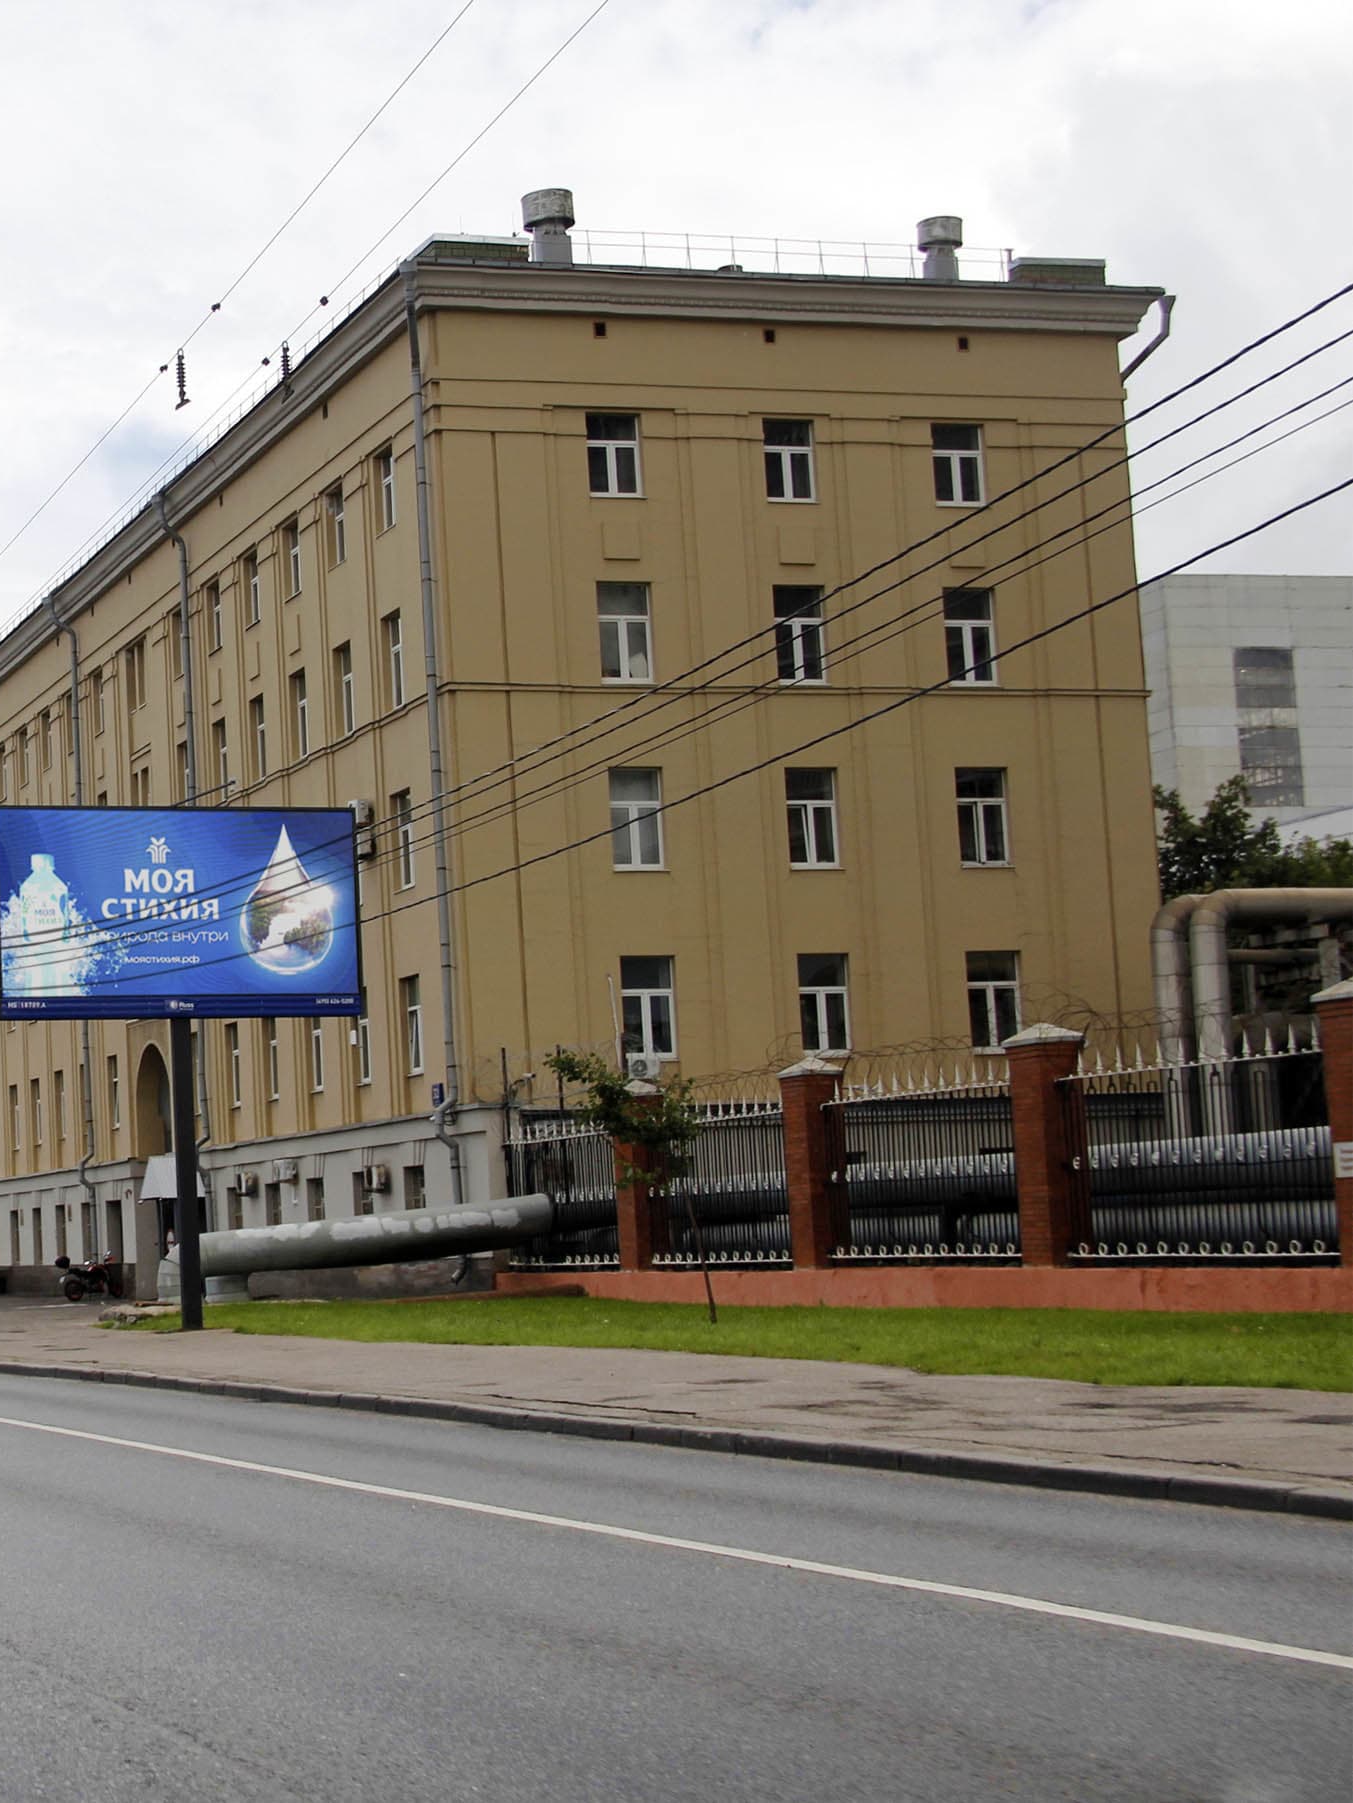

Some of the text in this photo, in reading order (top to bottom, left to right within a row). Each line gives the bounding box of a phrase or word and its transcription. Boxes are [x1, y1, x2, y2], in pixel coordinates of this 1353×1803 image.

[123, 868, 195, 893] МОЯ
[101, 897, 220, 920] СТИХИЯ
[172, 930, 229, 944] внутри
